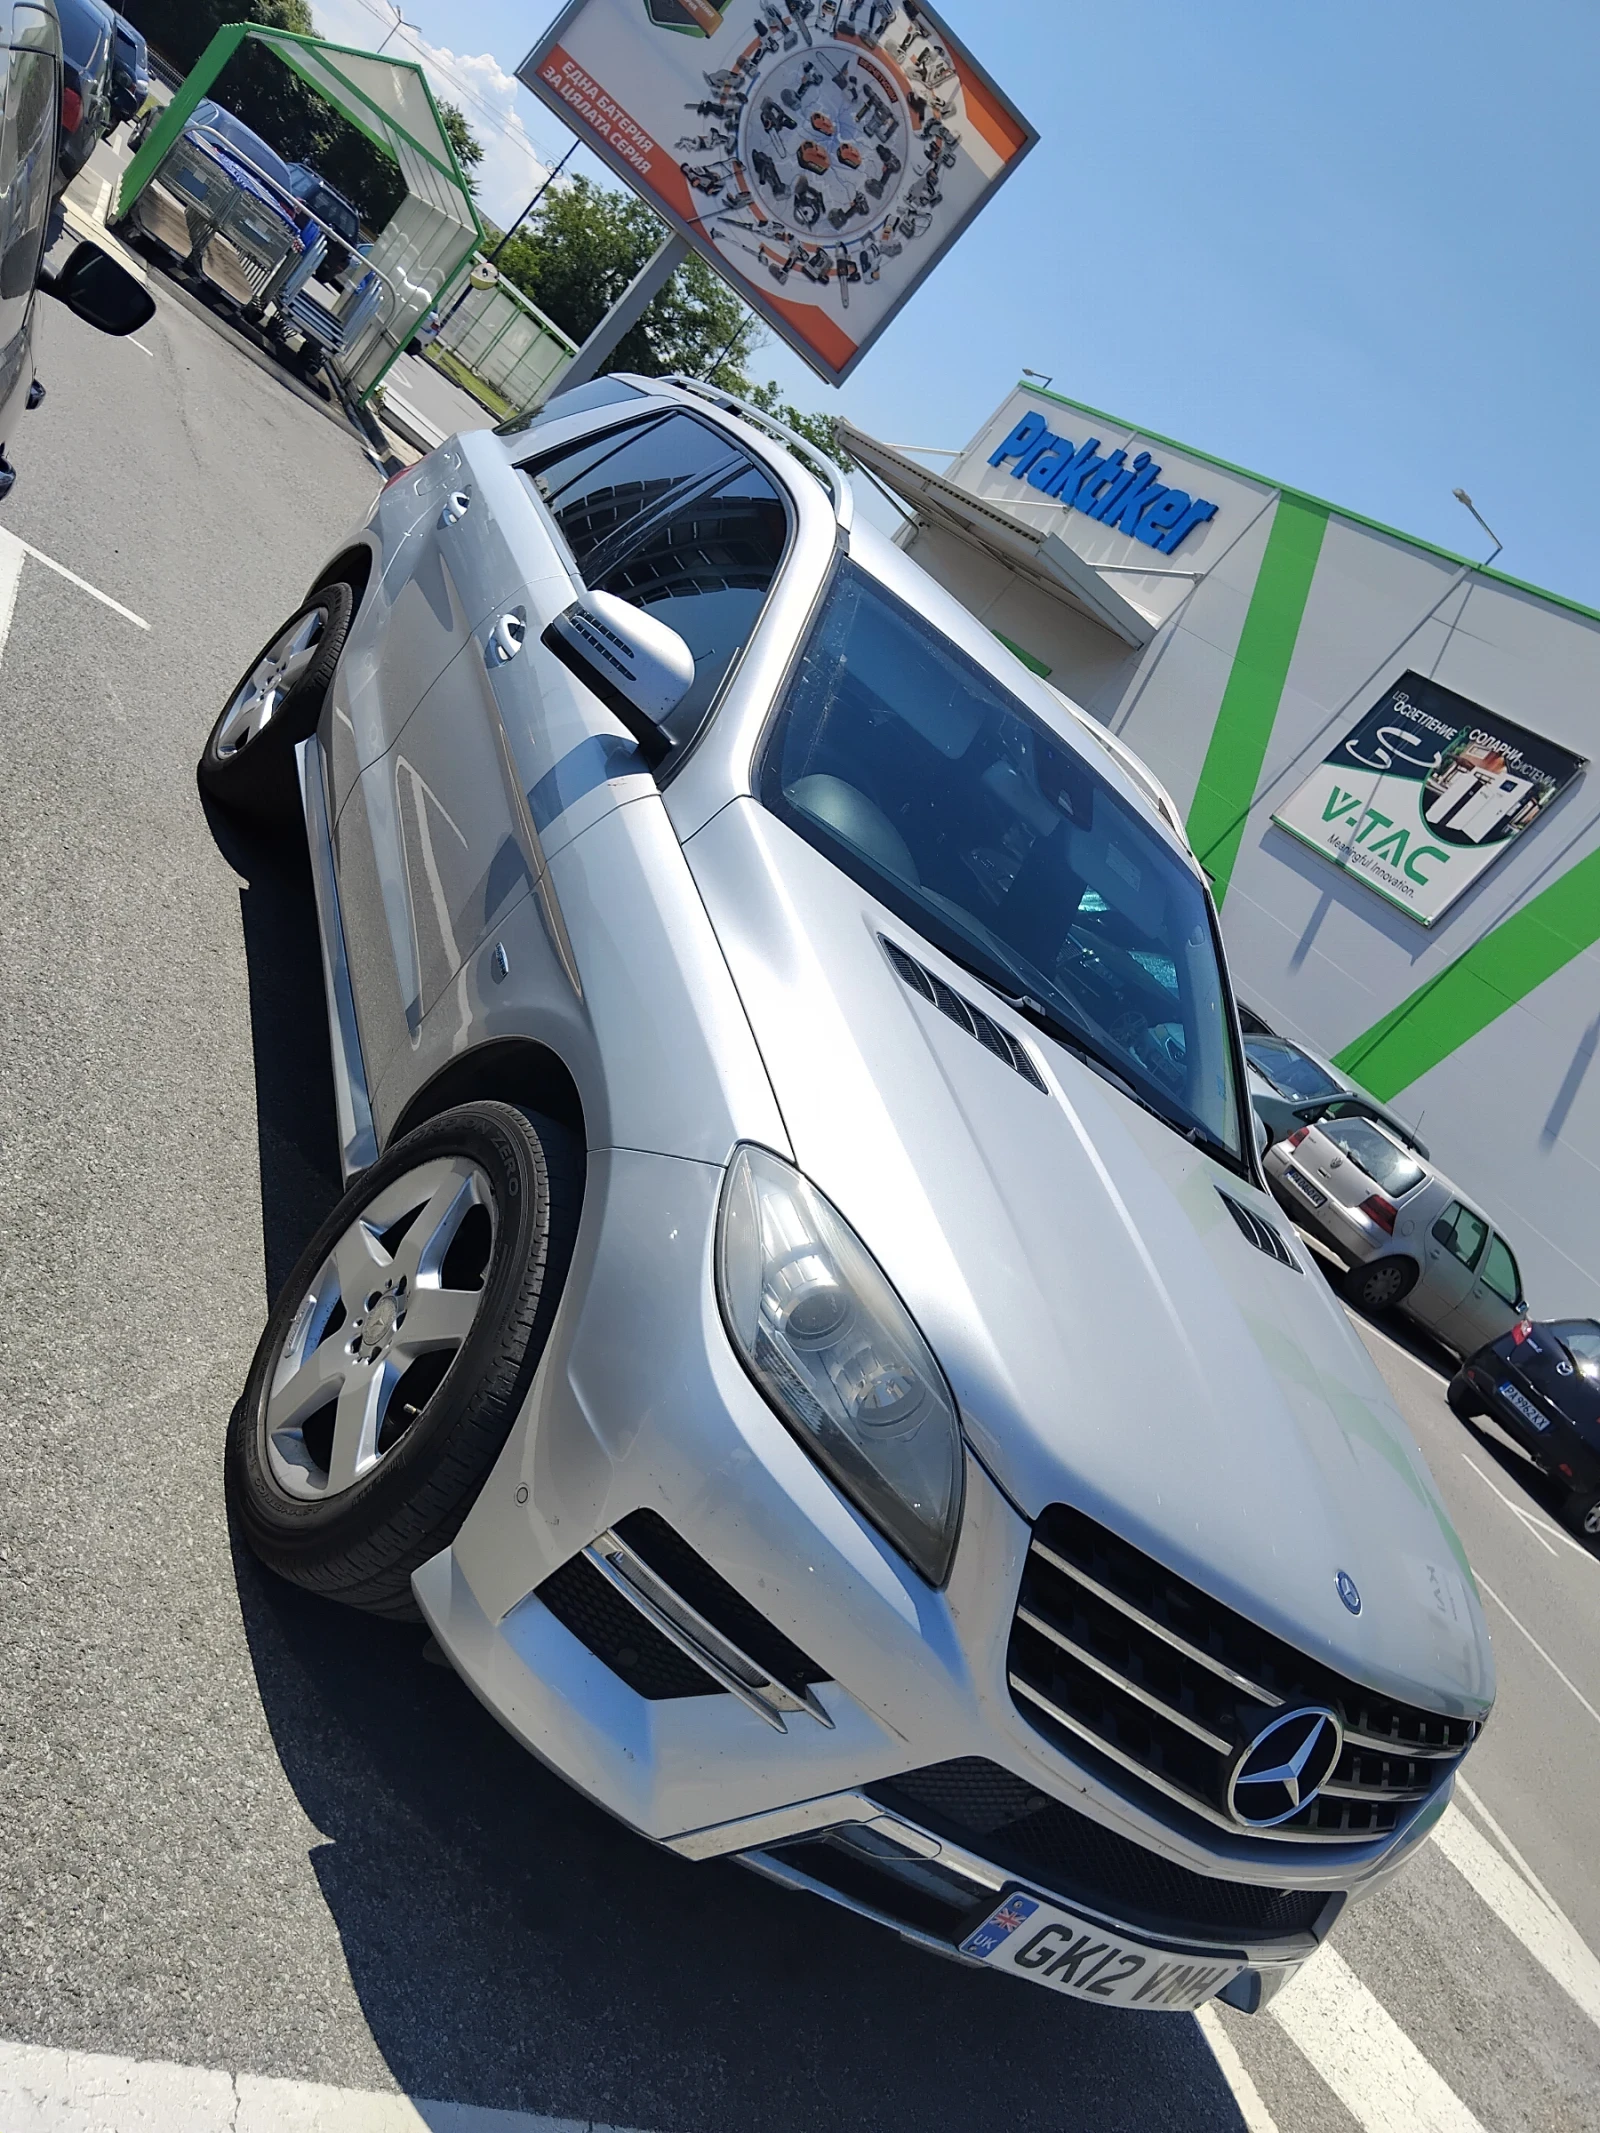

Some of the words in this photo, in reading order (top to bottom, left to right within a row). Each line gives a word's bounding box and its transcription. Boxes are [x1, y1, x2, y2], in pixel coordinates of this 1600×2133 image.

[542, 65, 563, 88] ЗА
[560, 83, 611, 136] ЦЯЛАТА
[609, 132, 652, 174] СЕРИЯ
[561, 61, 599, 100] ЕДНА
[596, 95, 654, 153] БАТЕРИЯ
[987, 410, 1219, 556] Praktiker
[1393, 701, 1458, 740] ОСВЕТЛЕНИЕ
[1468, 729, 1524, 763] СОЛАРНИ
[1321, 785, 1451, 886] V-TAC
[1327, 833, 1372, 869] Meaningful
[1370, 862, 1414, 898] Innovation.
[974, 1934, 998, 1950] UK
[1131, 1962, 1229, 2004] VNH
